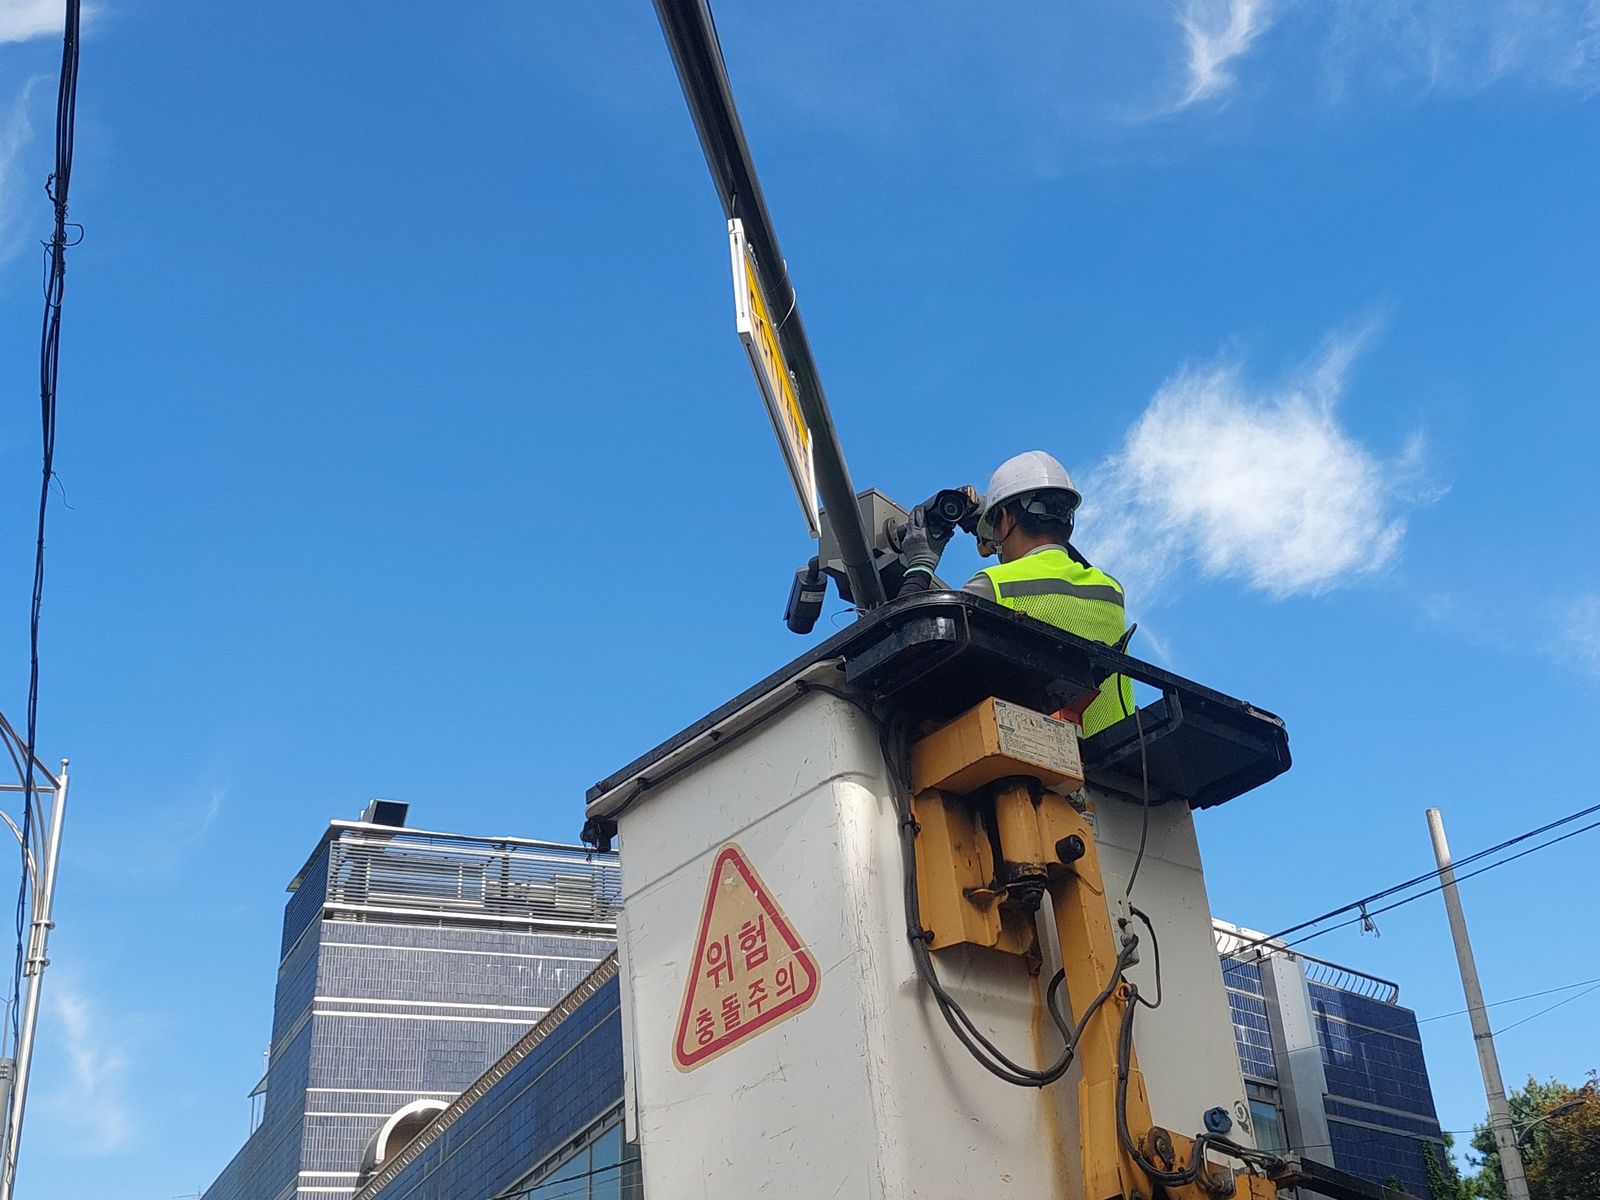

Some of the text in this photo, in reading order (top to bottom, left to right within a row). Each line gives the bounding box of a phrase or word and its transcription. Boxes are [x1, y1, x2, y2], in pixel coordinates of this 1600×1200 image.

[749, 289, 784, 401] CCTV
[706, 913, 769, 990] 위험
[695, 961, 797, 1046] 충돌주의
